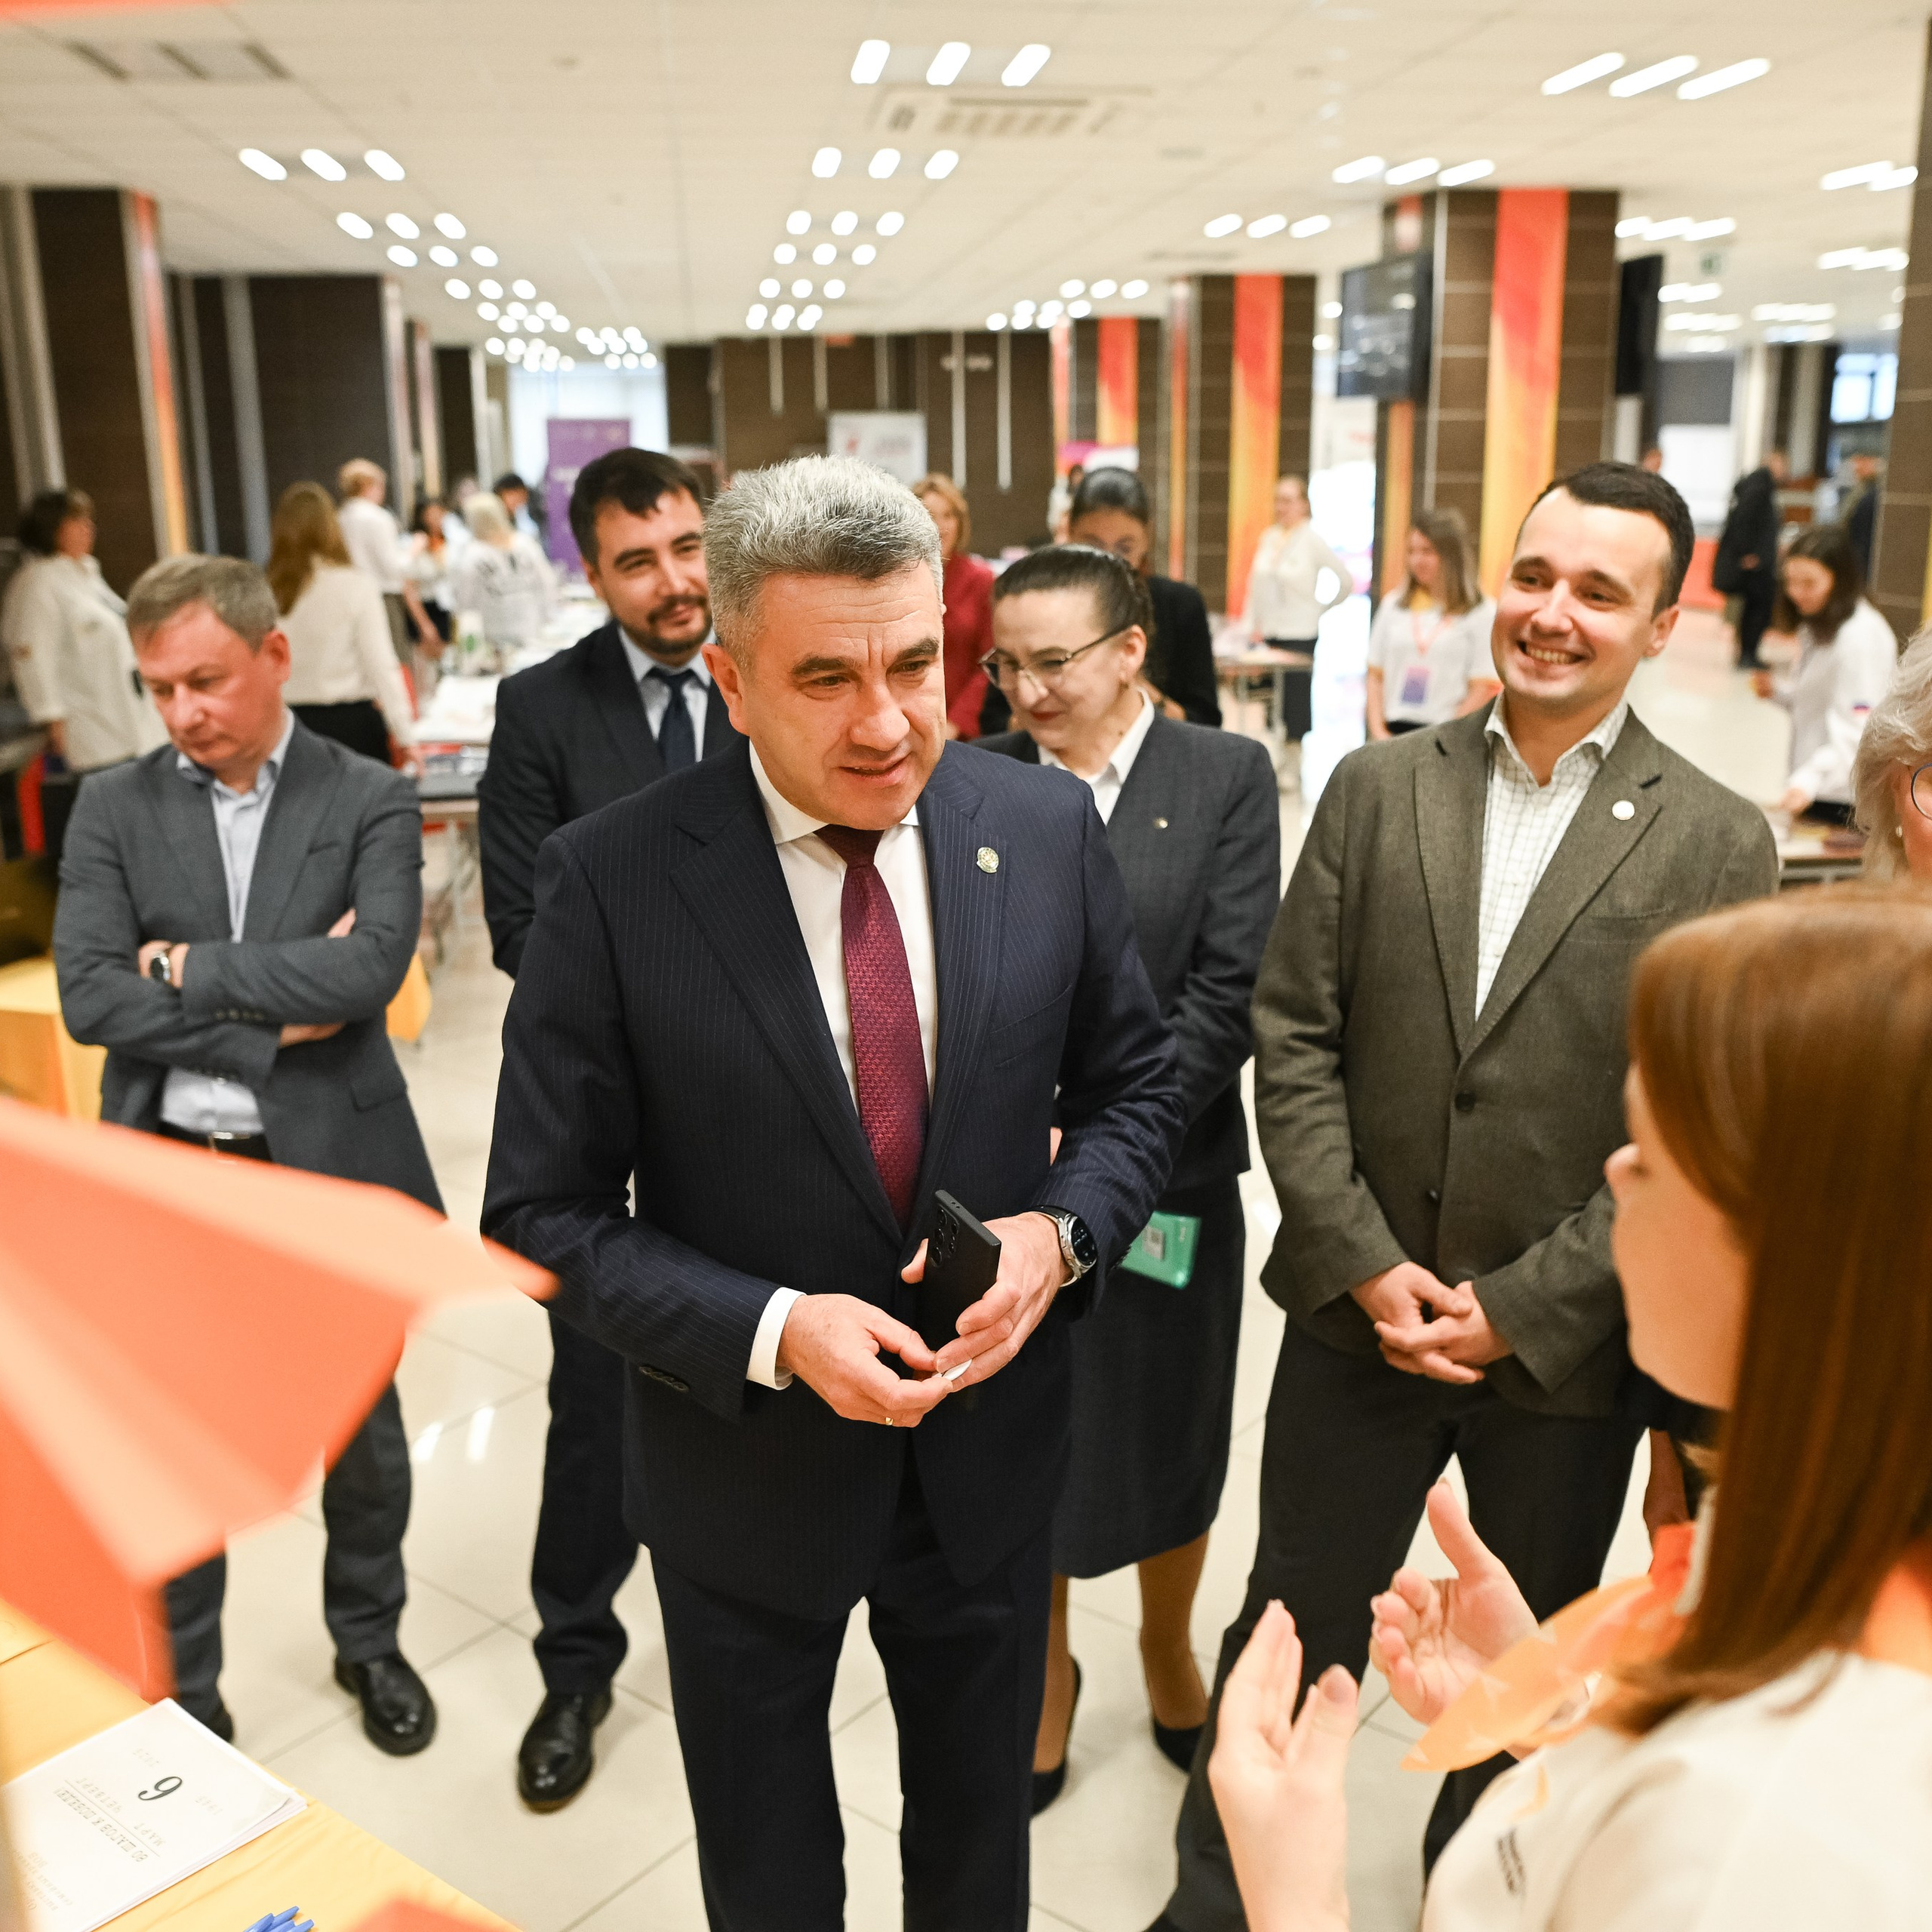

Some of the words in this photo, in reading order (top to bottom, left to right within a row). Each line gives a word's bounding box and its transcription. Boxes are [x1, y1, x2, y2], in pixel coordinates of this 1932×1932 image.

[137, 1776, 183, 1801] 6
[91, 1817, 105, 1826] К
[100, 1823, 137, 1852] ШАГОВ
[133, 1823, 165, 1846] МАРТ
[131, 1850, 149, 1863] 80
